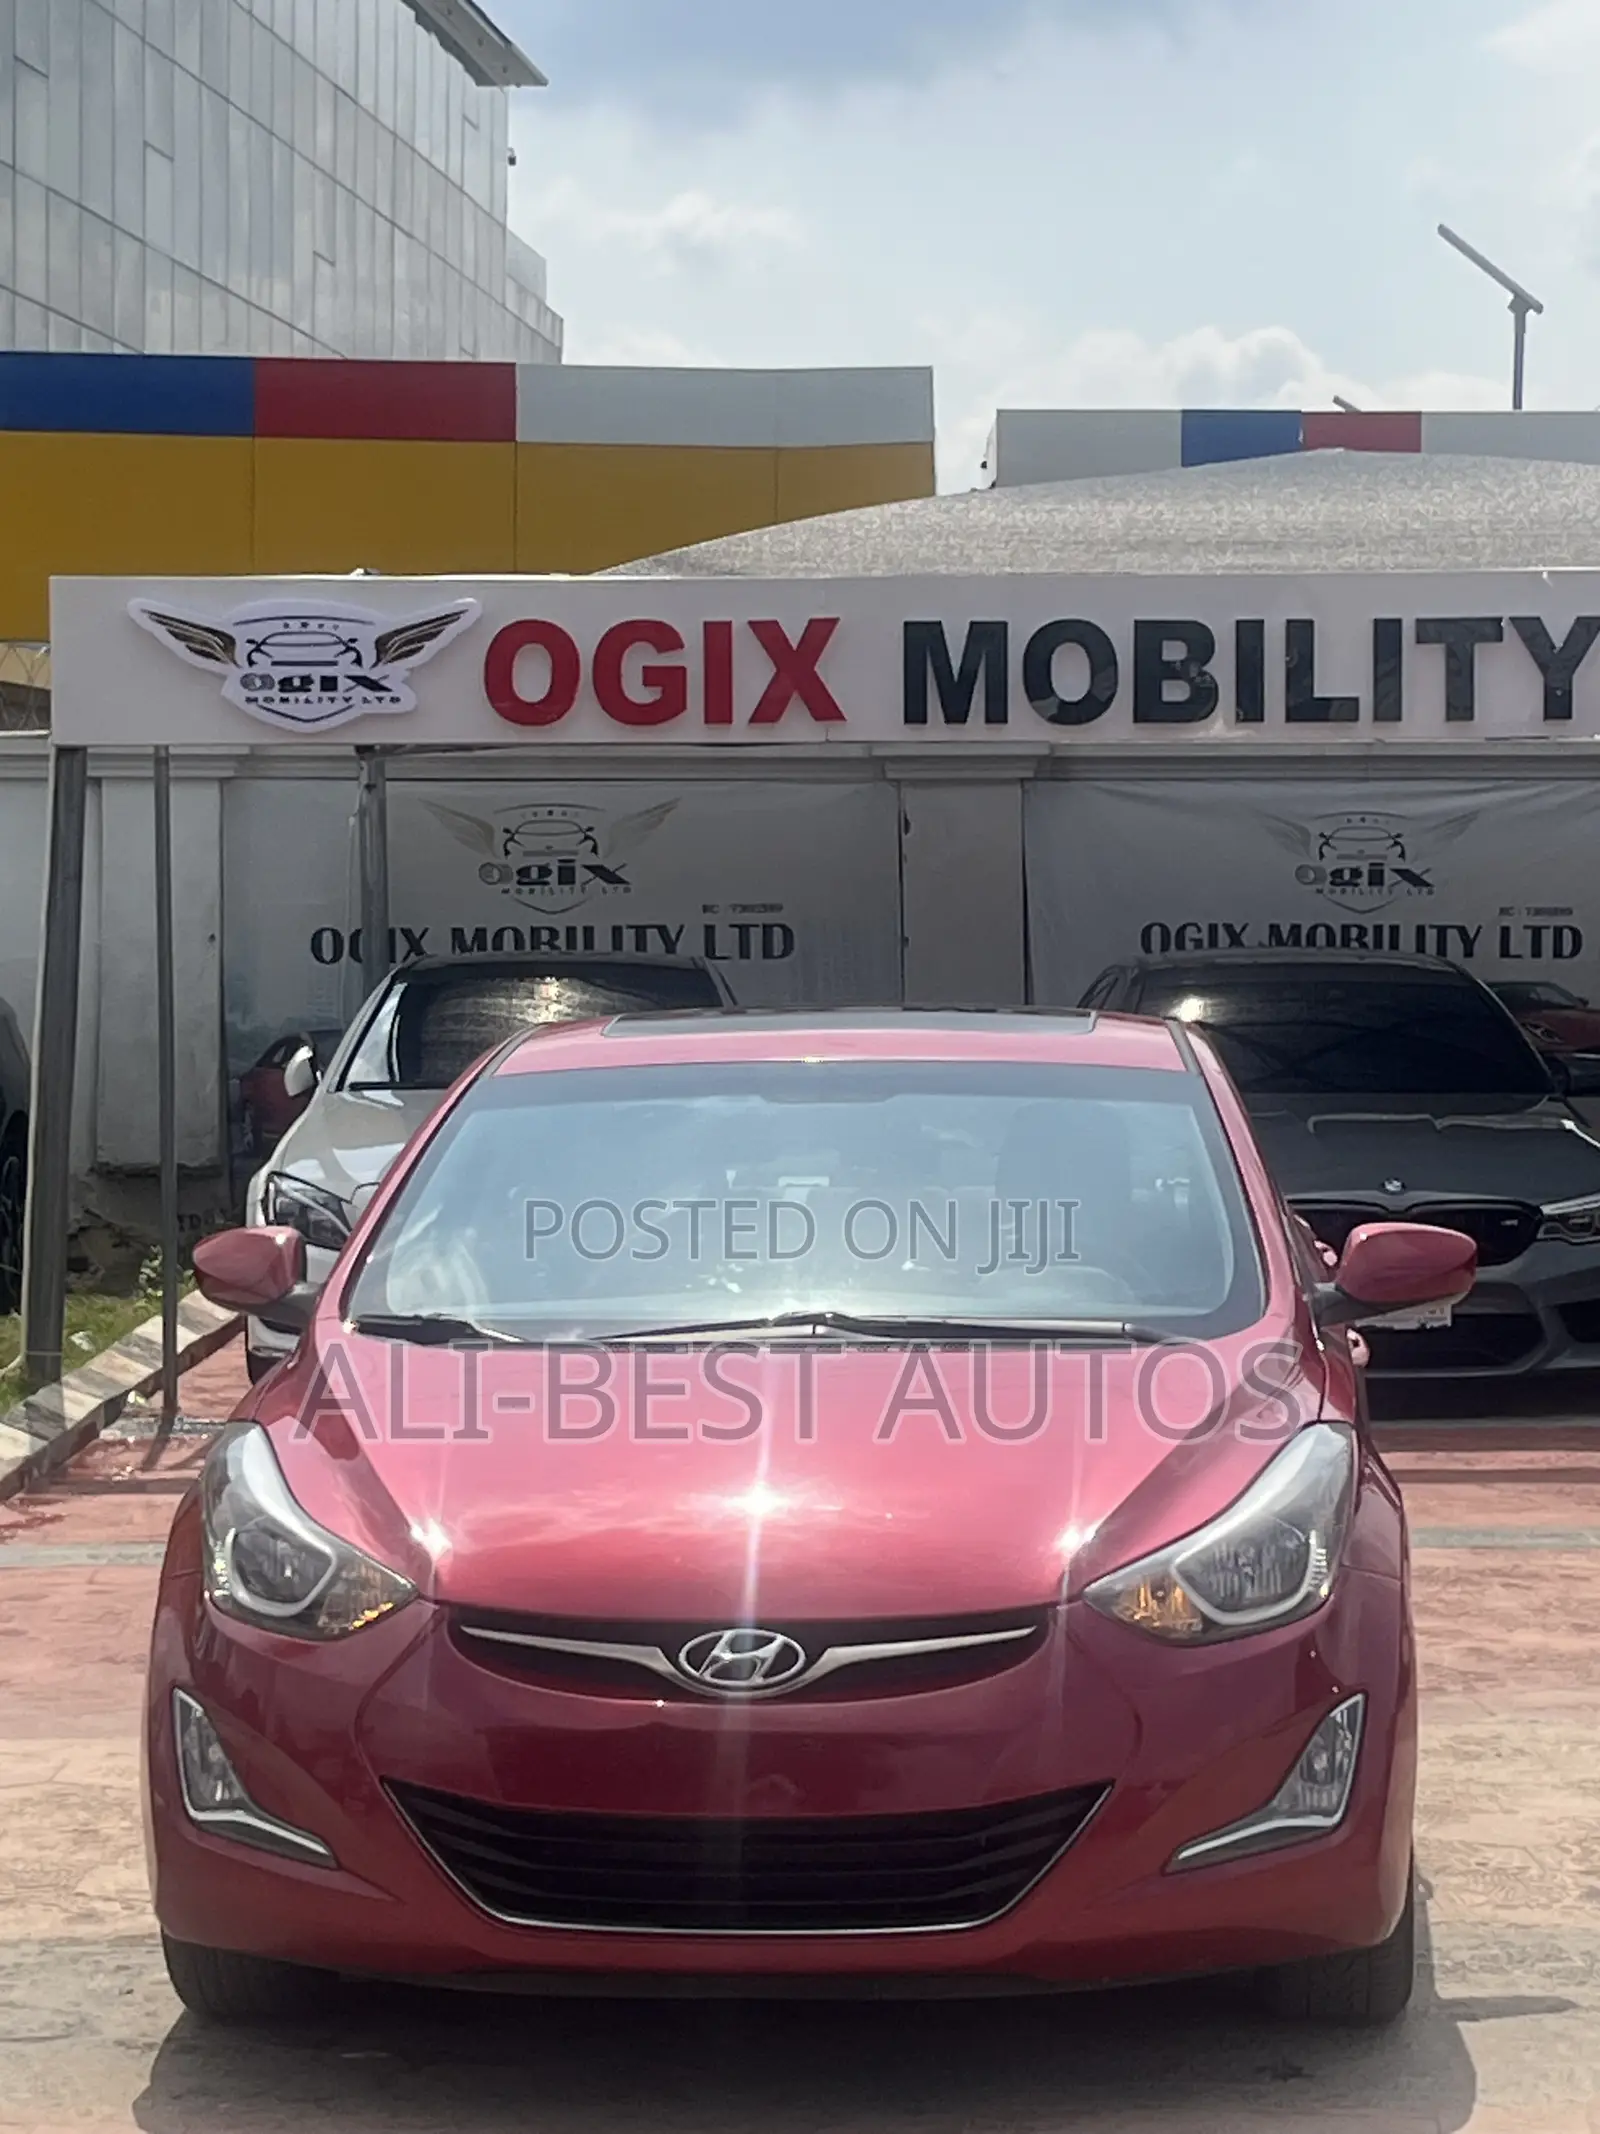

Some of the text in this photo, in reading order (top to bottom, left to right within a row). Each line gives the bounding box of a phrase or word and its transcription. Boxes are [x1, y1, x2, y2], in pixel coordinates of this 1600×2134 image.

[483, 615, 1600, 726] OGIX MOBILITY
[703, 923, 795, 960] LTD
[1140, 922, 1583, 959] OGIX MOBILITY LTD
